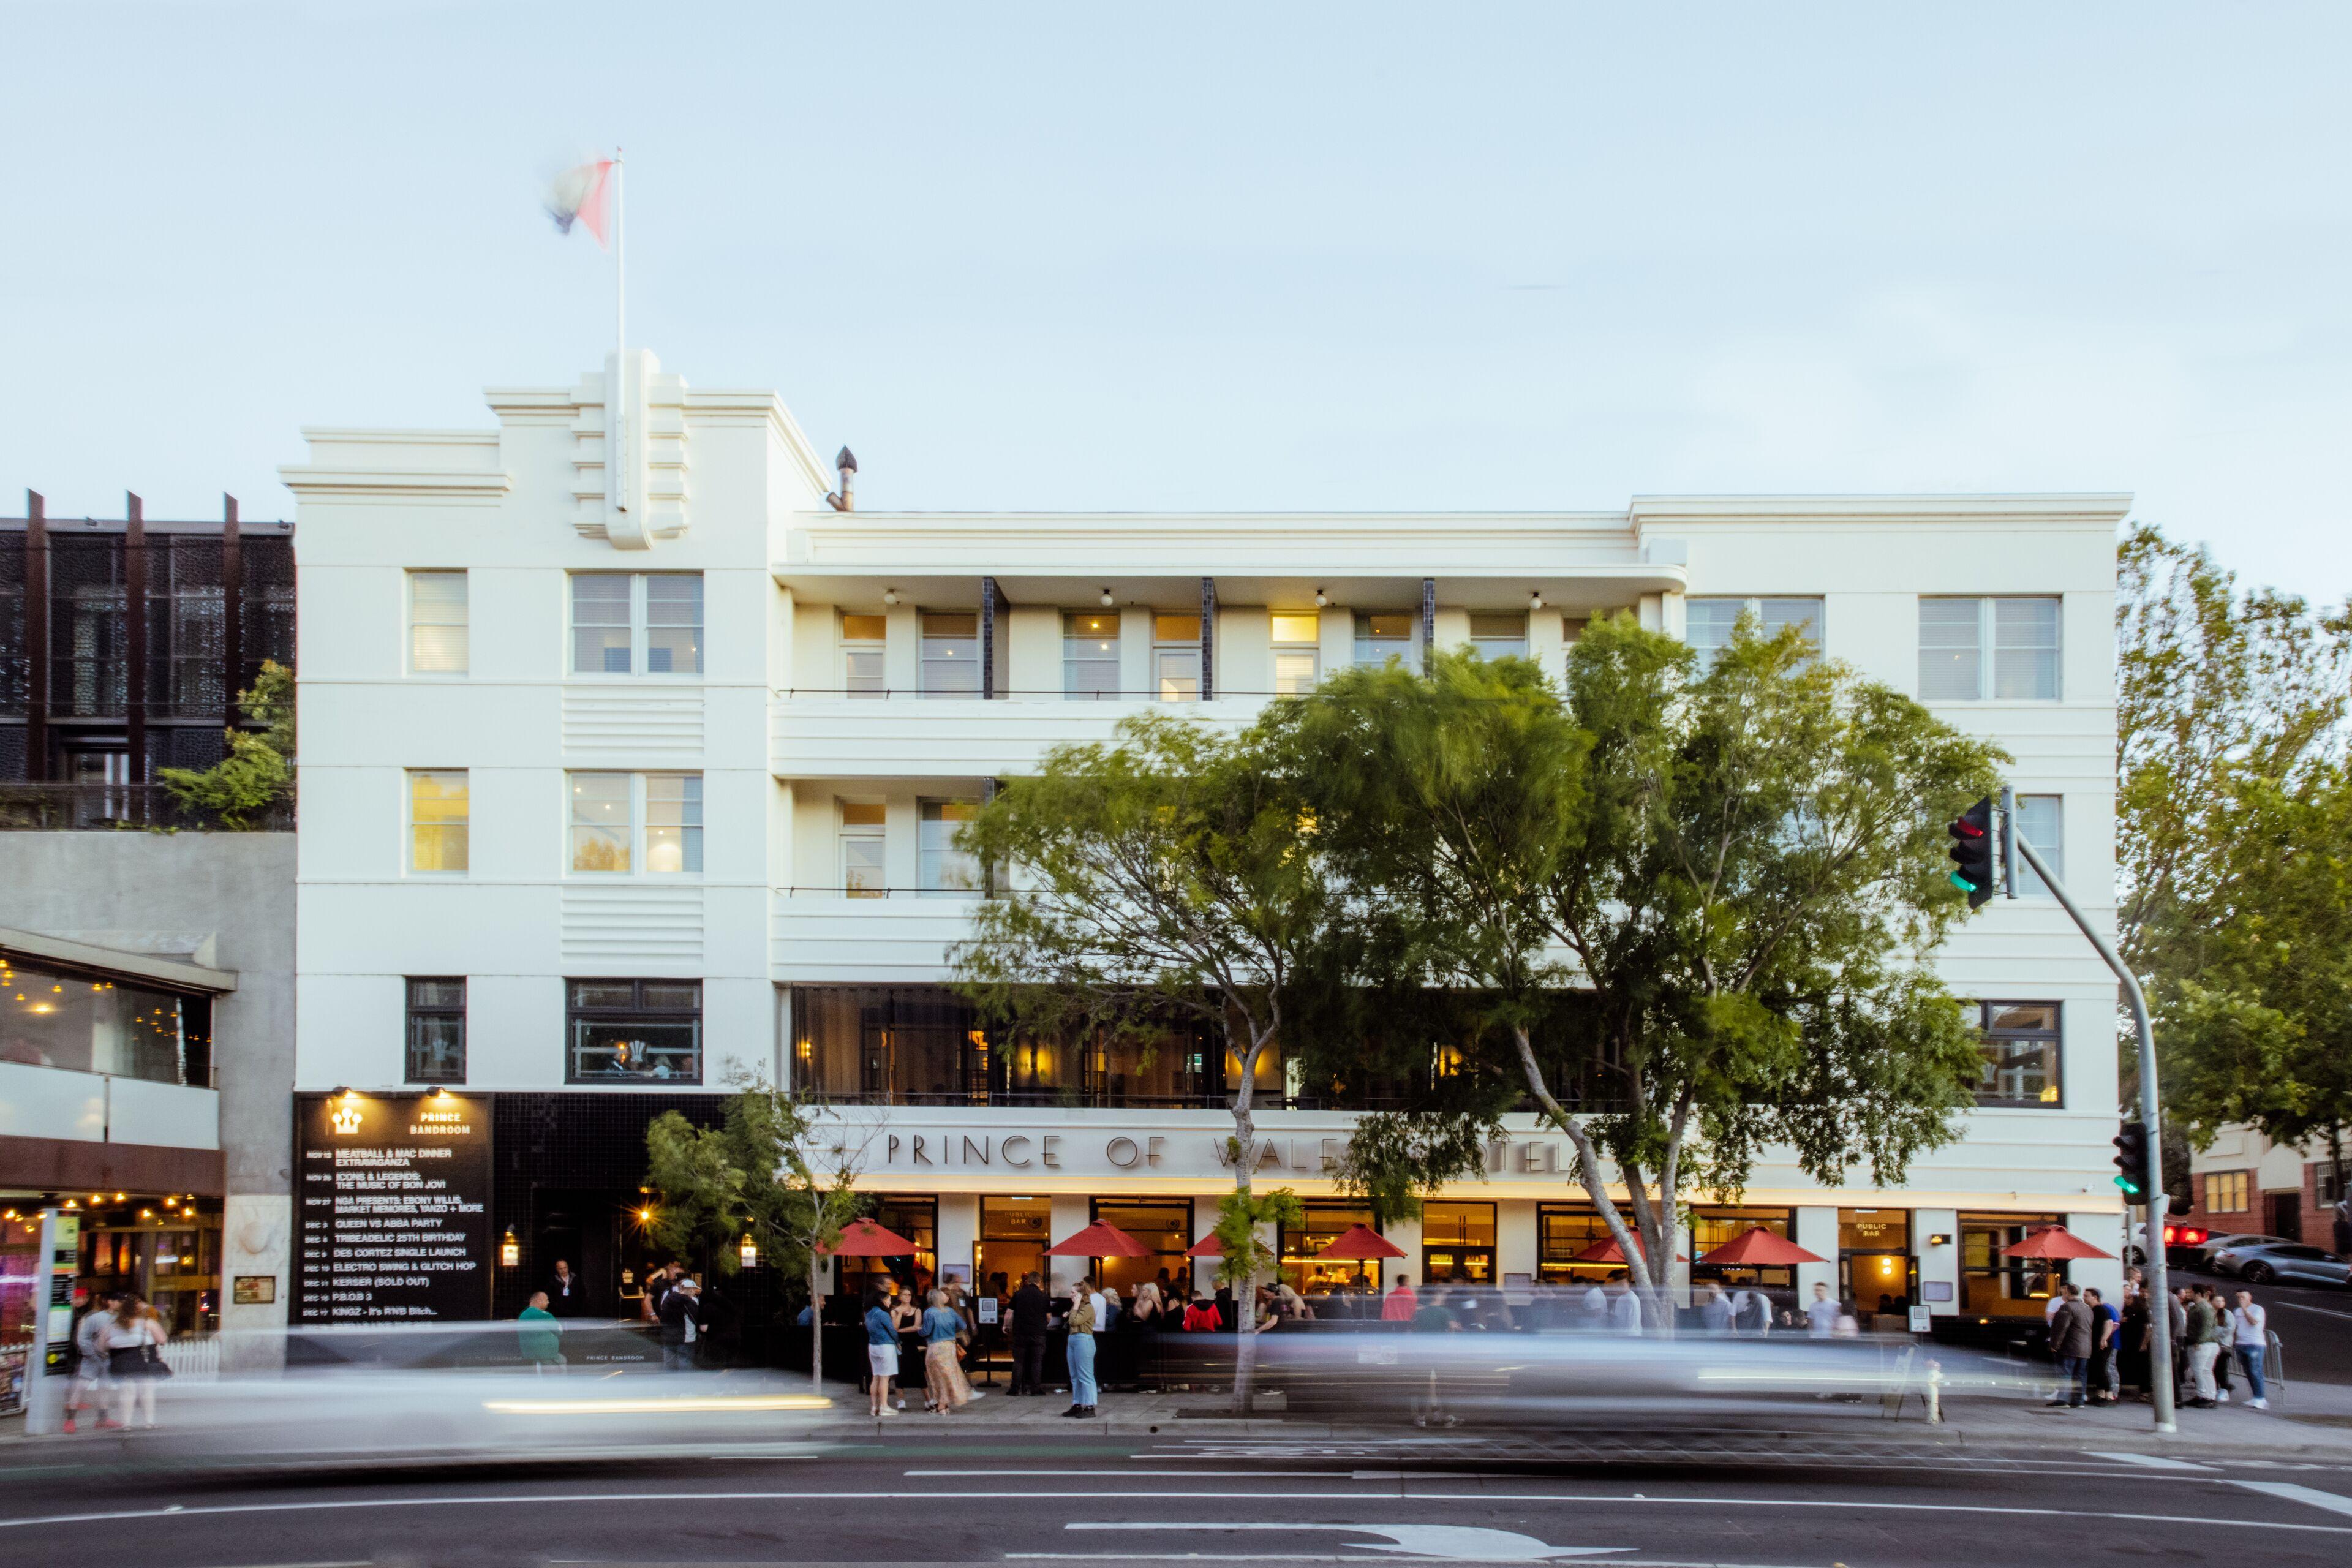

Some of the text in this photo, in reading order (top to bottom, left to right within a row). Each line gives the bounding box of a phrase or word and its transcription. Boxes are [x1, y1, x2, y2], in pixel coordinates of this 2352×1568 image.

[421, 1112, 461, 1122] PRINCE
[410, 1125, 470, 1134] BANDROOM
[336, 1148, 452, 1158] MEATBALL & MAC DINNER
[888, 1134, 1572, 1172] PRINCE OF WALE OTEL
[336, 1158, 410, 1167] EXTRAVAGANZA
[336, 1171, 421, 1181] ICONS & LEGENDS:
[425, 1180, 446, 1189] JOVI
[403, 1195, 432, 1204] EBONY
[335, 1218, 443, 1228] QUEEN VS ABBA PARTY
[334, 1232, 466, 1242] TRIBEADELIC 25TH BIRTHDAY
[334, 1247, 466, 1257] DES CORTEZ SINGLE LAUNCH
[333, 1261, 477, 1271] ELECTRO SWING & GLITCH HOP
[333, 1276, 429, 1287] KERSER (SOLD OUT)
[332, 1306, 362, 1316] KINGZ
[384, 1306, 407, 1315] RNB
